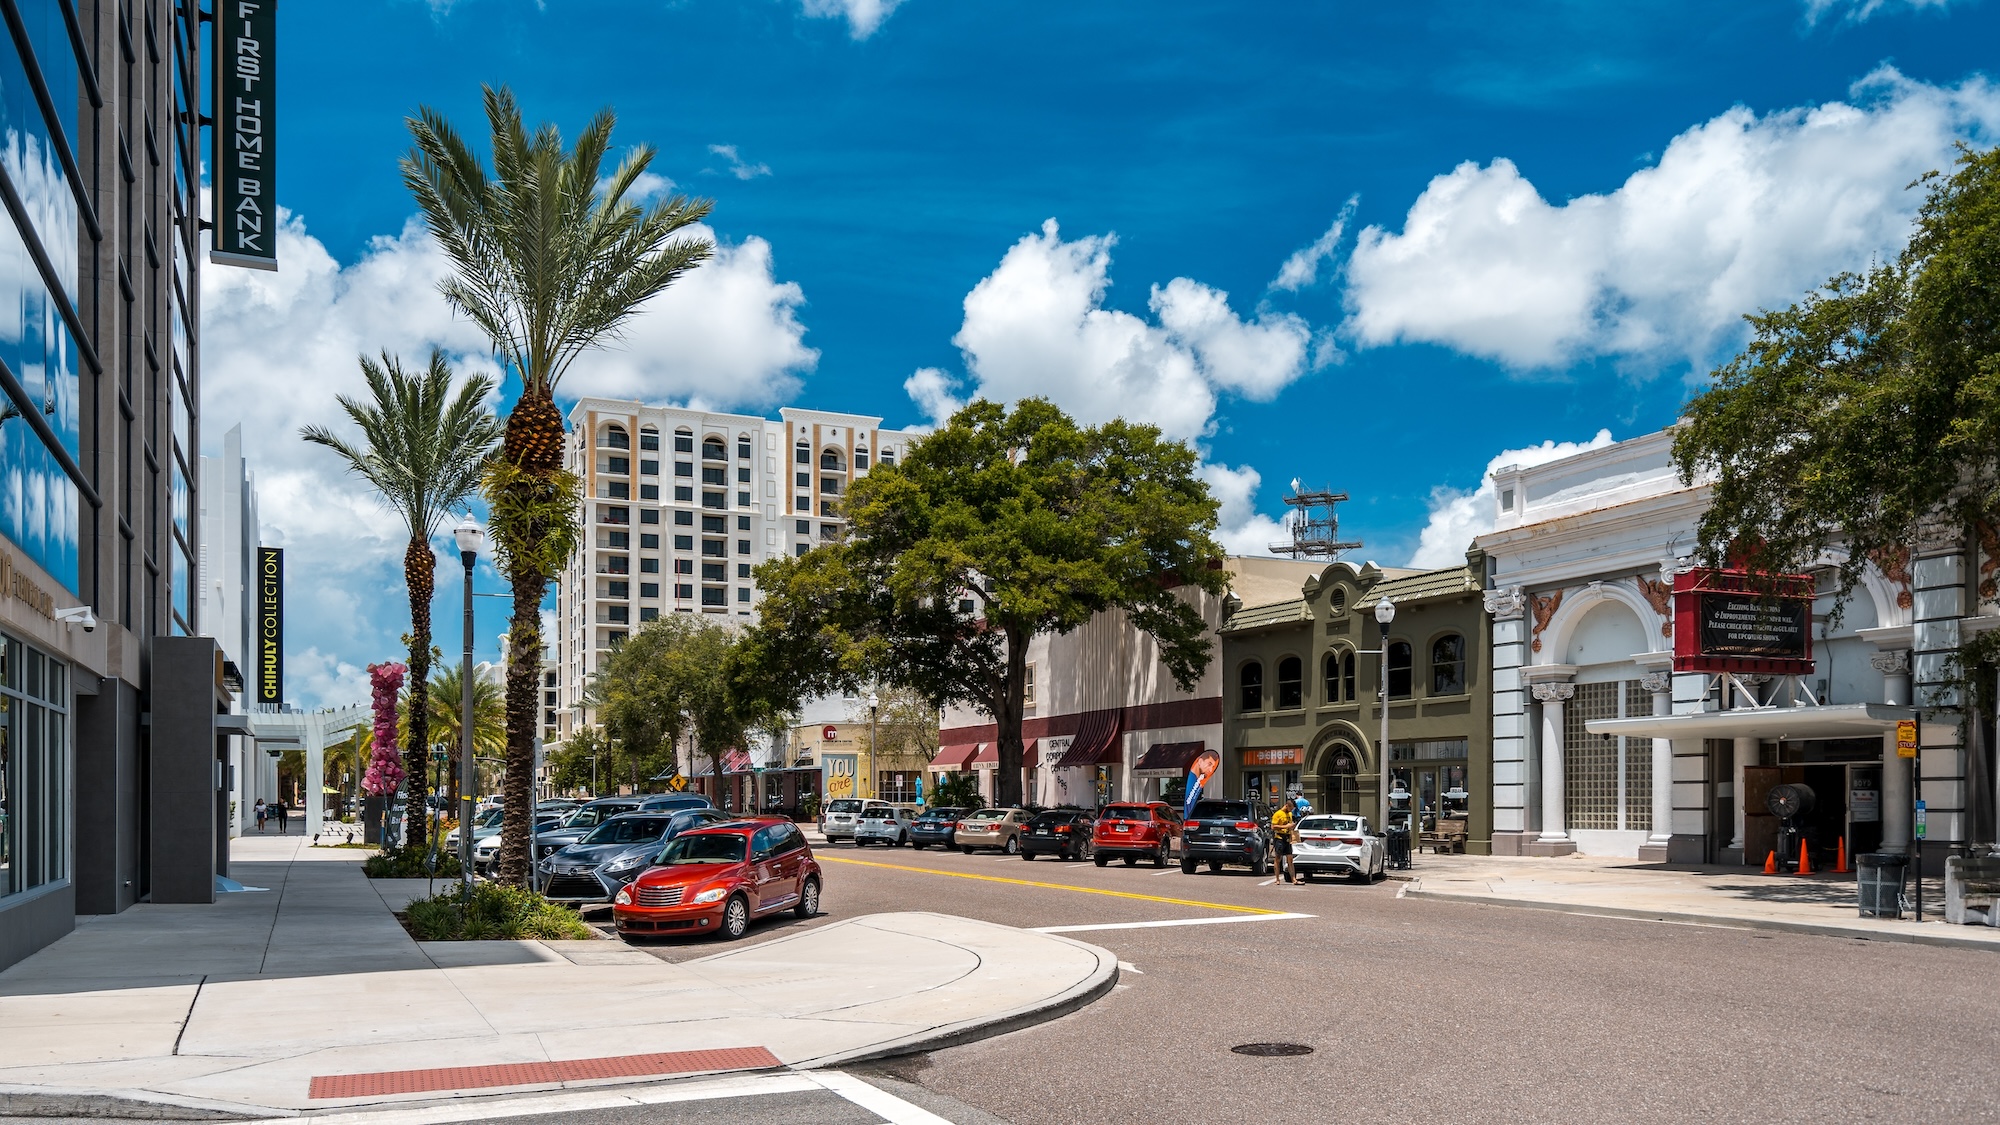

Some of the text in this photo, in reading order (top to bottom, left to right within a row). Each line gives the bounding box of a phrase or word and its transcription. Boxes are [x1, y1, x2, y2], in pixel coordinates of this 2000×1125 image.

[236, 1, 263, 252] FIRST HOME BANK
[1727, 602, 1749, 611] EXCITING
[1714, 611, 1720, 619] &
[1720, 611, 1756, 621] IMPROVEMENTS
[264, 551, 278, 699] CHIHULY COLLECTION
[1708, 620, 1726, 629] PLEASE
[1049, 739, 1070, 748] CENTRAL
[1336, 758, 1347, 767] 689
[827, 758, 855, 778] YOU
[829, 777, 851, 793] are
